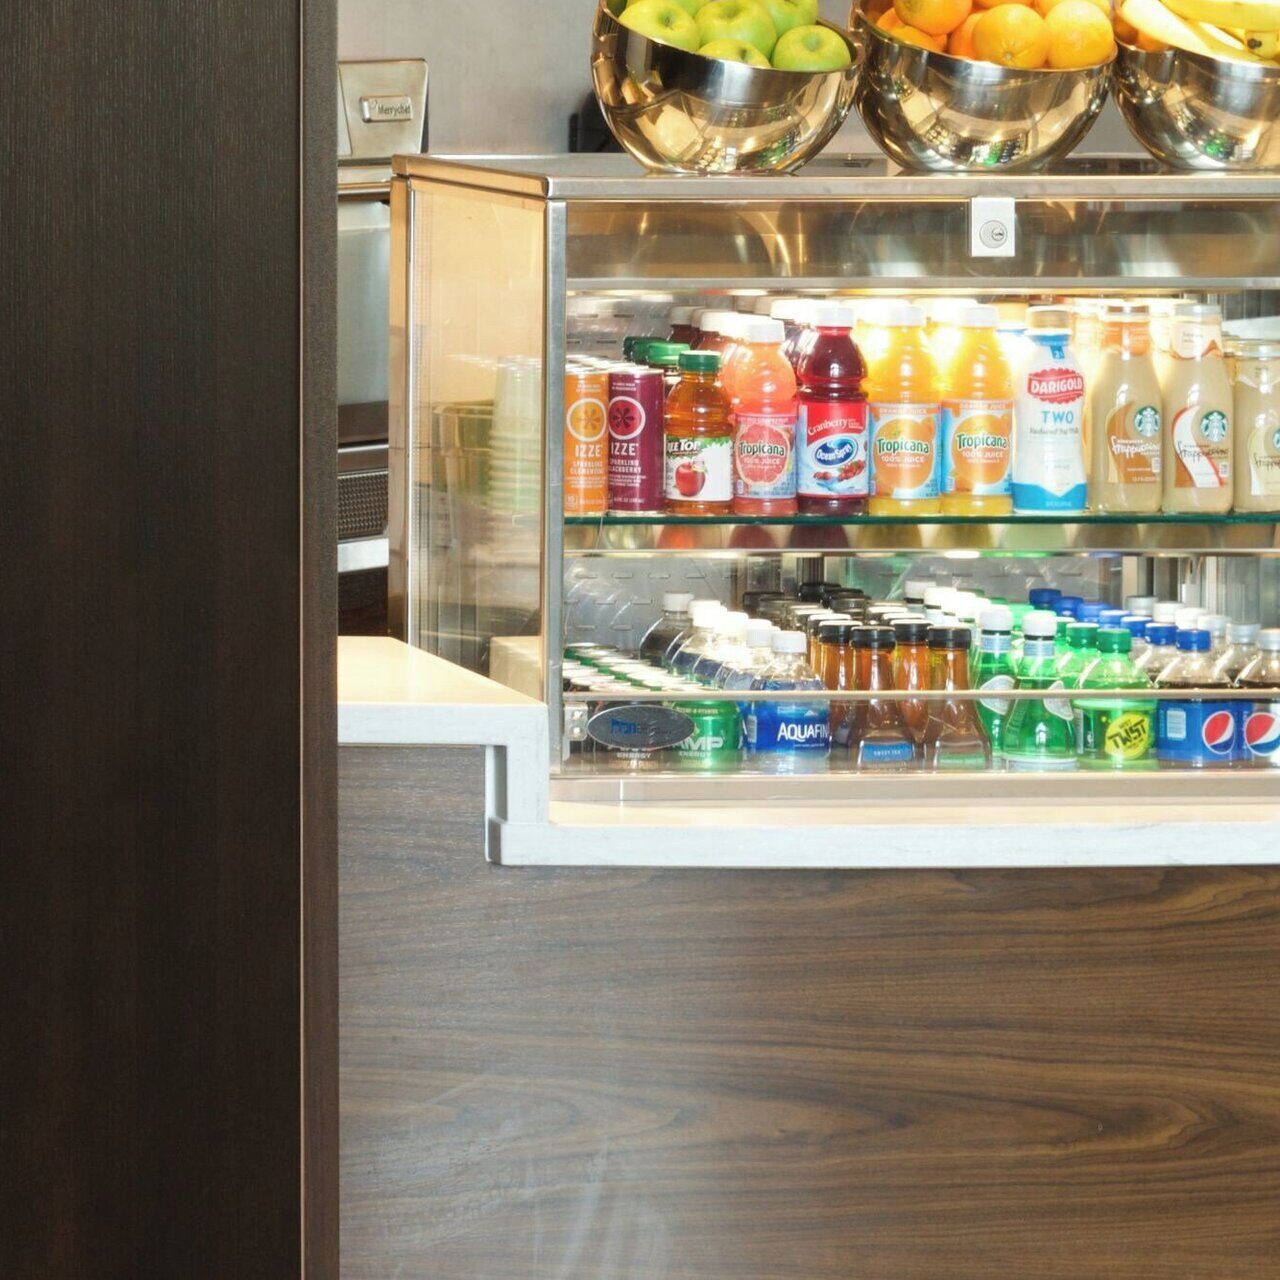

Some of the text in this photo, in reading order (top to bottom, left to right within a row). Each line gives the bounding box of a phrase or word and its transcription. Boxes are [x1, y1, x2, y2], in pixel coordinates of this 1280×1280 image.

[1031, 377, 1083, 394] DARIGOLD
[1042, 411, 1074, 423] TWO
[808, 418, 847, 436] Cranberry
[611, 443, 636, 455] IZZE
[877, 438, 929, 454] Tropicana
[957, 434, 1007, 449] Tropicana
[575, 445, 601, 457] IZZE
[740, 443, 784, 456] Tropicana
[817, 443, 852, 461] Ocean Spray
